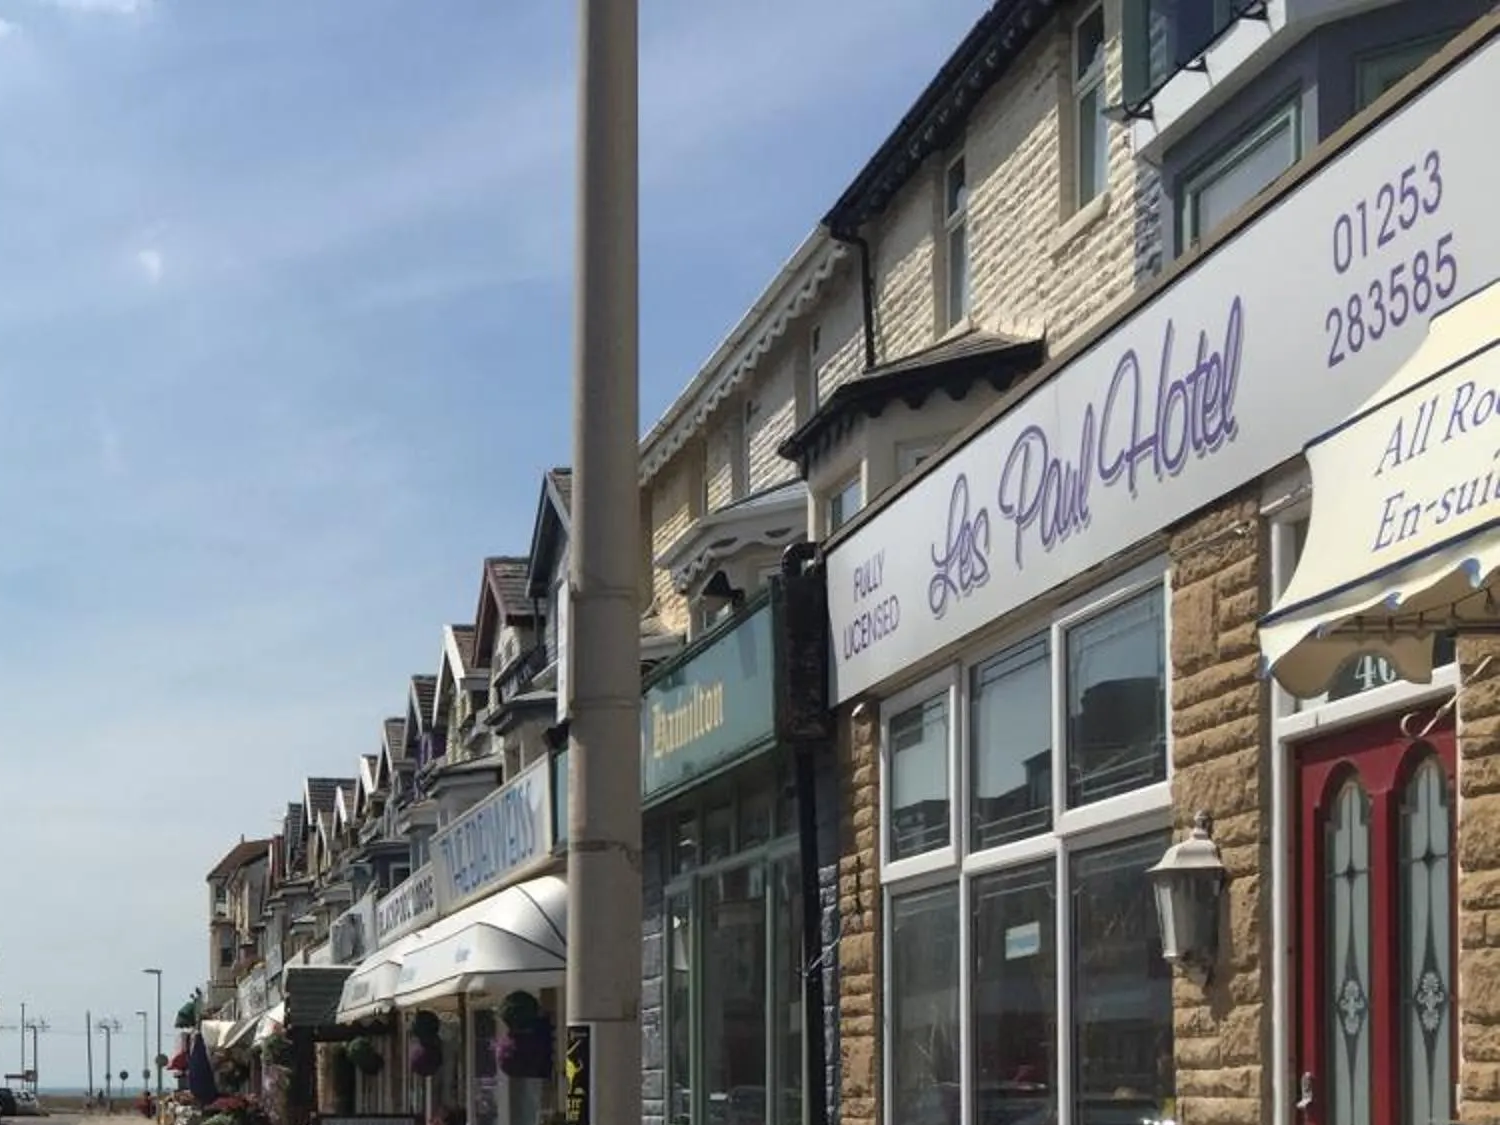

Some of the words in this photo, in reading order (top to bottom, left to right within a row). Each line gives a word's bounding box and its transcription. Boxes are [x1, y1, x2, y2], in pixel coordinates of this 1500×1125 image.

[1332, 149, 1443, 274] 01253
[1325, 232, 1457, 368] 283585
[928, 472, 990, 620] Les
[998, 401, 1096, 570] Paul
[1098, 294, 1244, 499] Hotel
[1373, 393, 1439, 477] All
[1441, 380, 1500, 443] Ro
[1371, 449, 1500, 552] En-sui
[853, 549, 885, 602] FULLY
[843, 594, 900, 661] LICENSED
